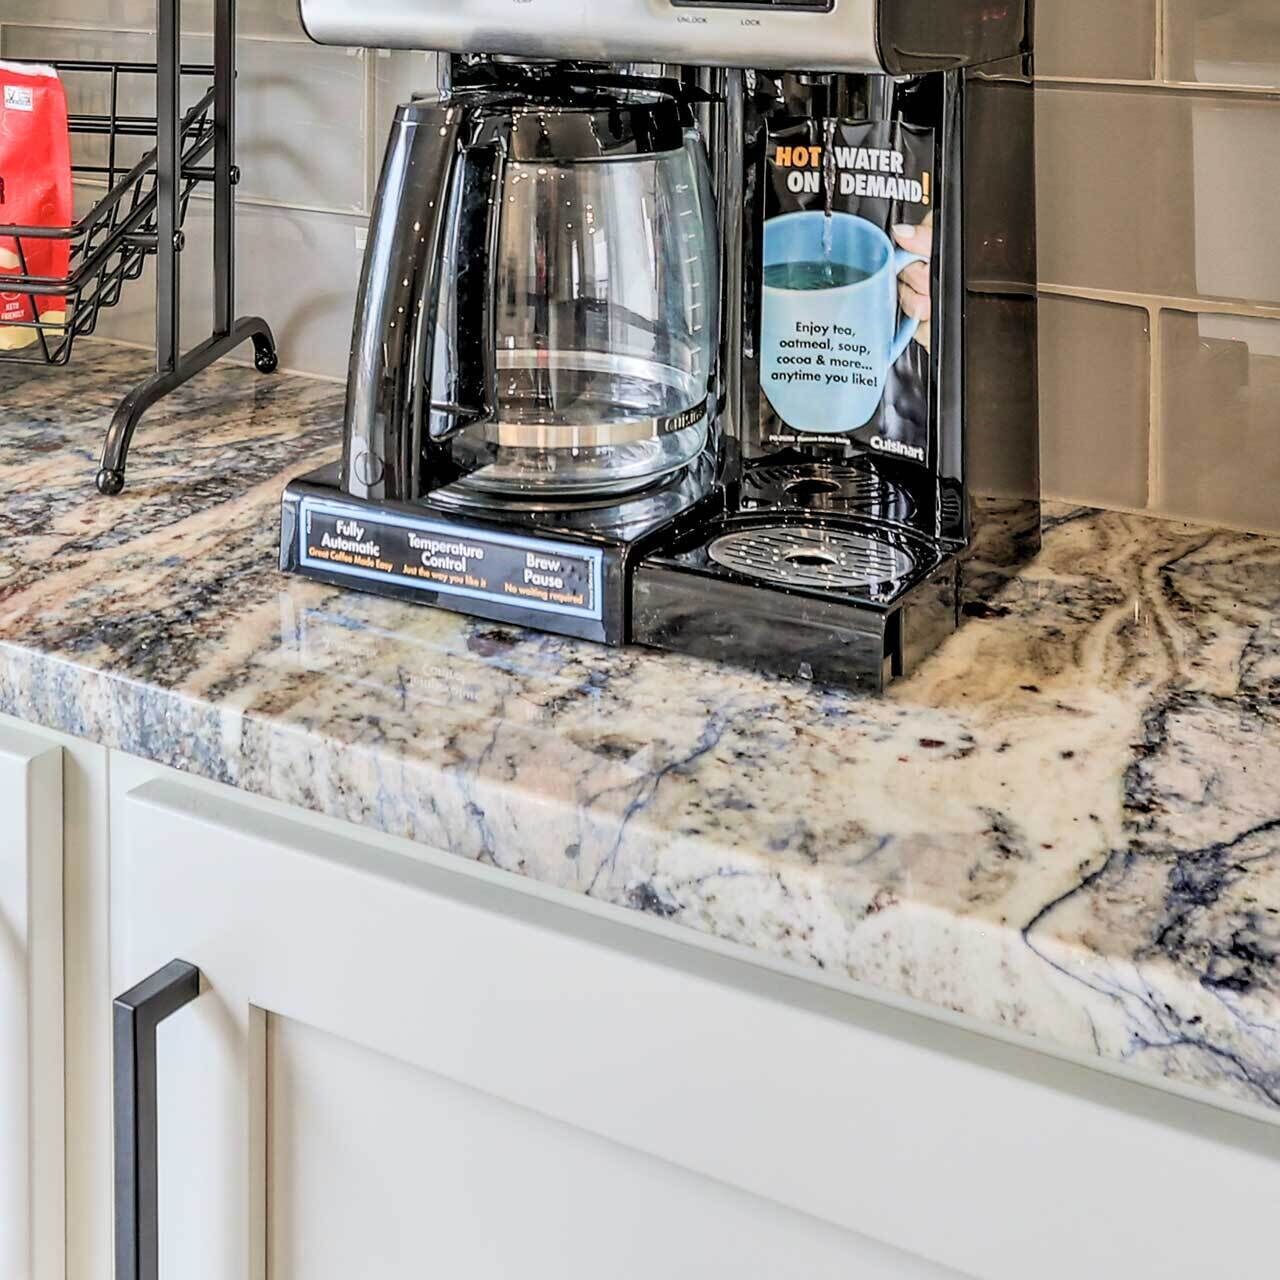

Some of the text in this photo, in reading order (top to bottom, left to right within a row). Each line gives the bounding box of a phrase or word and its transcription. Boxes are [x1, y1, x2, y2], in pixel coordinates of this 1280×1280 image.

[775, 146, 903, 174] HOT WATER
[787, 171, 930, 205] ON DEMAND!
[796, 322, 856, 337] Enjoy tea,
[779, 338, 871, 355] oatmeal, soup,
[777, 355, 872, 370] cocoa & more...
[771, 370, 878, 387] anytime you like!
[870, 435, 924, 462] Cuisinart
[336, 519, 365, 541] Fully
[321, 532, 380, 557] Automatic
[408, 532, 484, 560] Temperature
[309, 546, 393, 573] Great Coffee Made Easy
[421, 551, 467, 573] Control
[526, 553, 561, 573] Brew
[403, 564, 417, 576] Just
[419, 566, 431, 578] the
[432, 571, 449, 583] way
[449, 574, 464, 585] you
[465, 575, 479, 587] like
[524, 570, 563, 590] Pause
[504, 582, 584, 605] No waiting required
